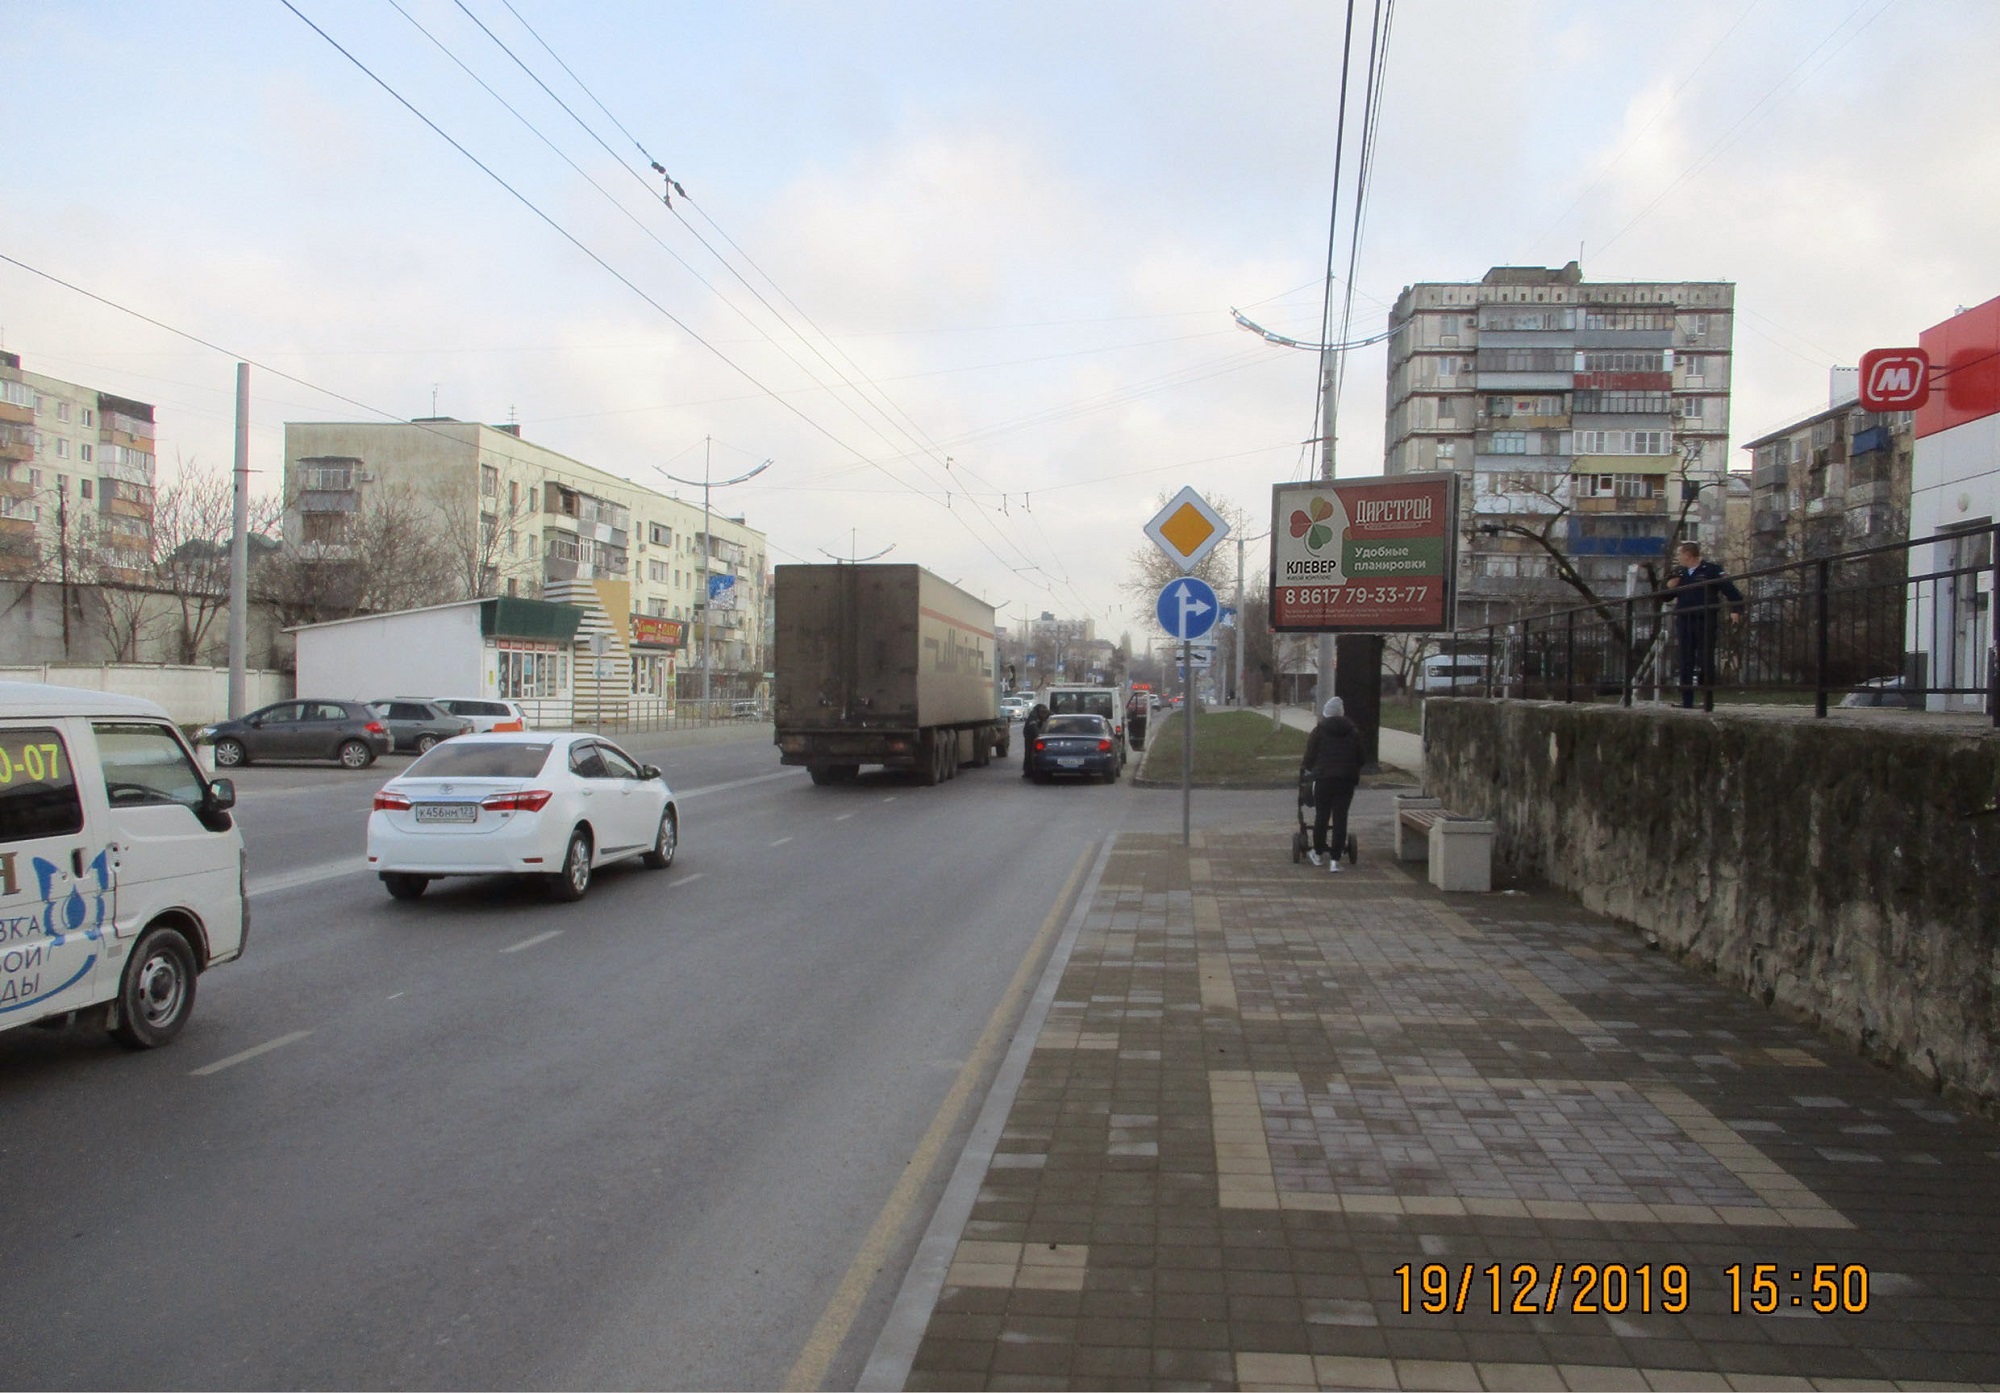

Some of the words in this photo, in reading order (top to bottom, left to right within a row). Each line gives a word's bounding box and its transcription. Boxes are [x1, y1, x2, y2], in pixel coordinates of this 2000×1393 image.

[1876, 367, 1910, 392] М
[1355, 496, 1432, 524] ДАРСТРОЙ
[1354, 546, 1409, 559] Удобные
[1286, 560, 1337, 575] КЛЕВЕР
[1354, 559, 1426, 572] планировки
[1285, 589, 1296, 605] 8
[1299, 588, 1341, 605] 8617
[1346, 586, 1428, 604] 79-33-77
[0, 944, 42, 973] ОЙ
